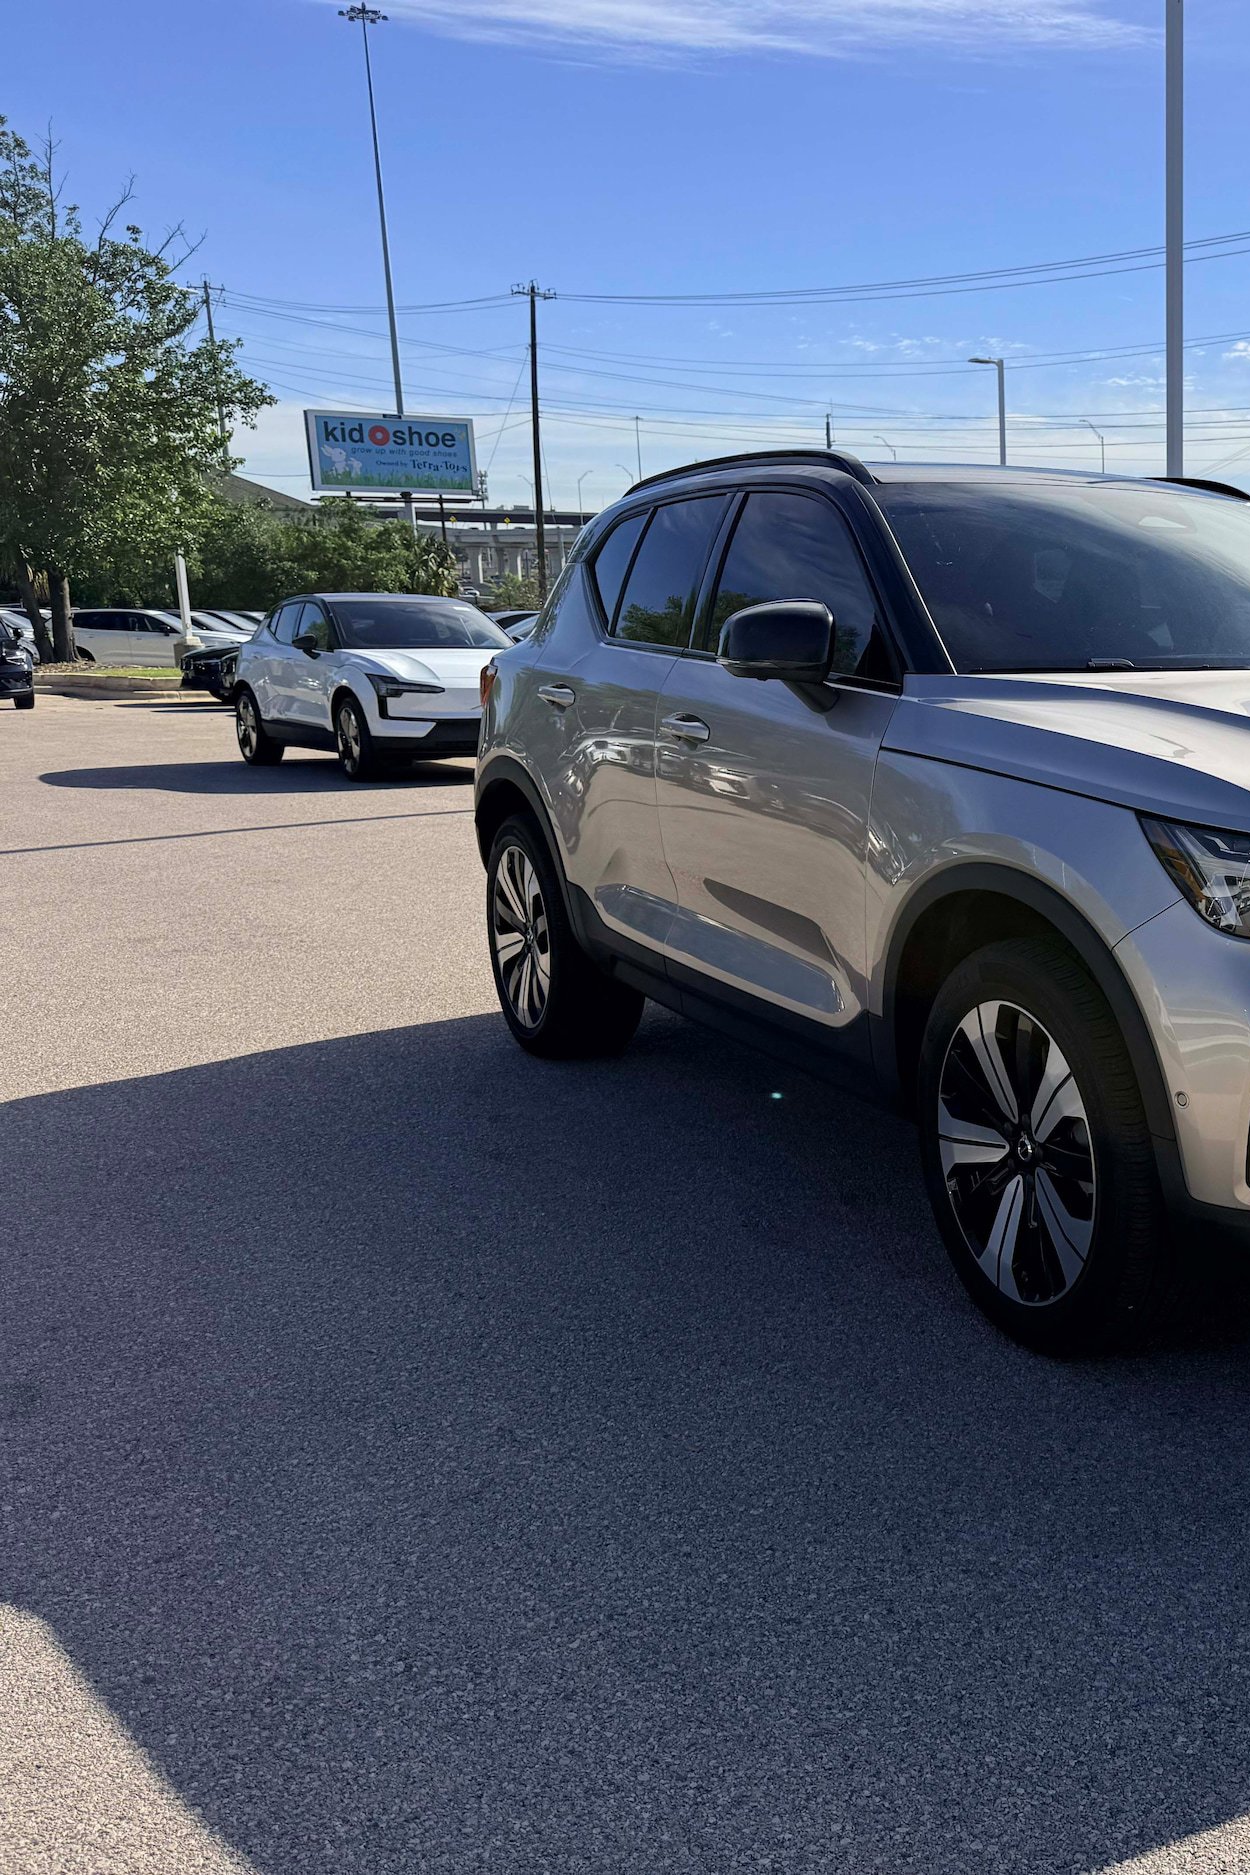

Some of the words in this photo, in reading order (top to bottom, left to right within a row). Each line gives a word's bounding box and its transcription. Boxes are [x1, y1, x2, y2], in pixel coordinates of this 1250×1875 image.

[323, 421, 364, 443] kid
[392, 426, 457, 448] shoe
[409, 449, 430, 457] good
